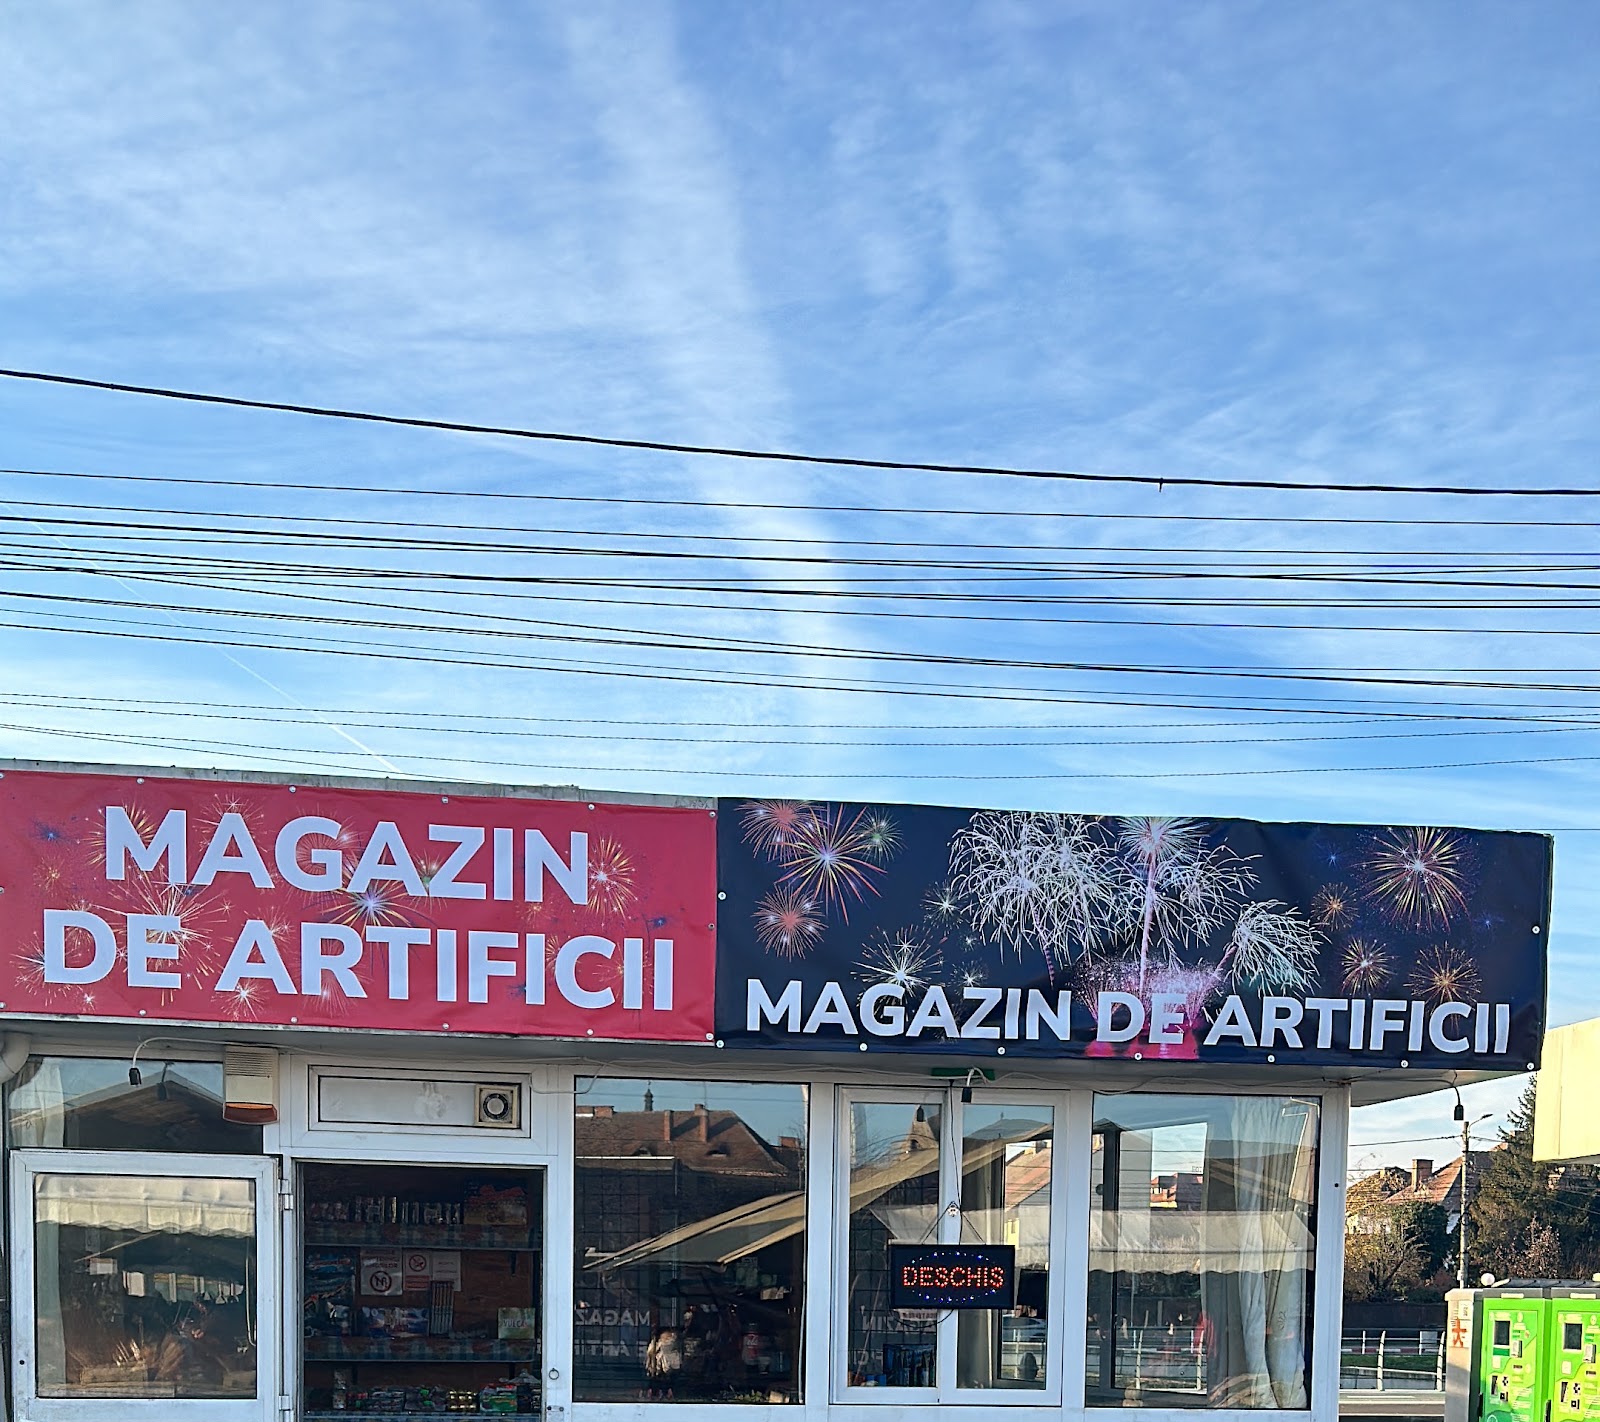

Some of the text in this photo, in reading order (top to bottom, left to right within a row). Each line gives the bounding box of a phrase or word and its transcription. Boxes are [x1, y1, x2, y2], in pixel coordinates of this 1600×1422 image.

[105, 805, 589, 905] MAGAZIN
[43, 908, 674, 1011] DE ARTIFICII
[746, 978, 1511, 1054] MAGAZIN DE ARTIFICII
[903, 1266, 1004, 1288] DESCHIS
